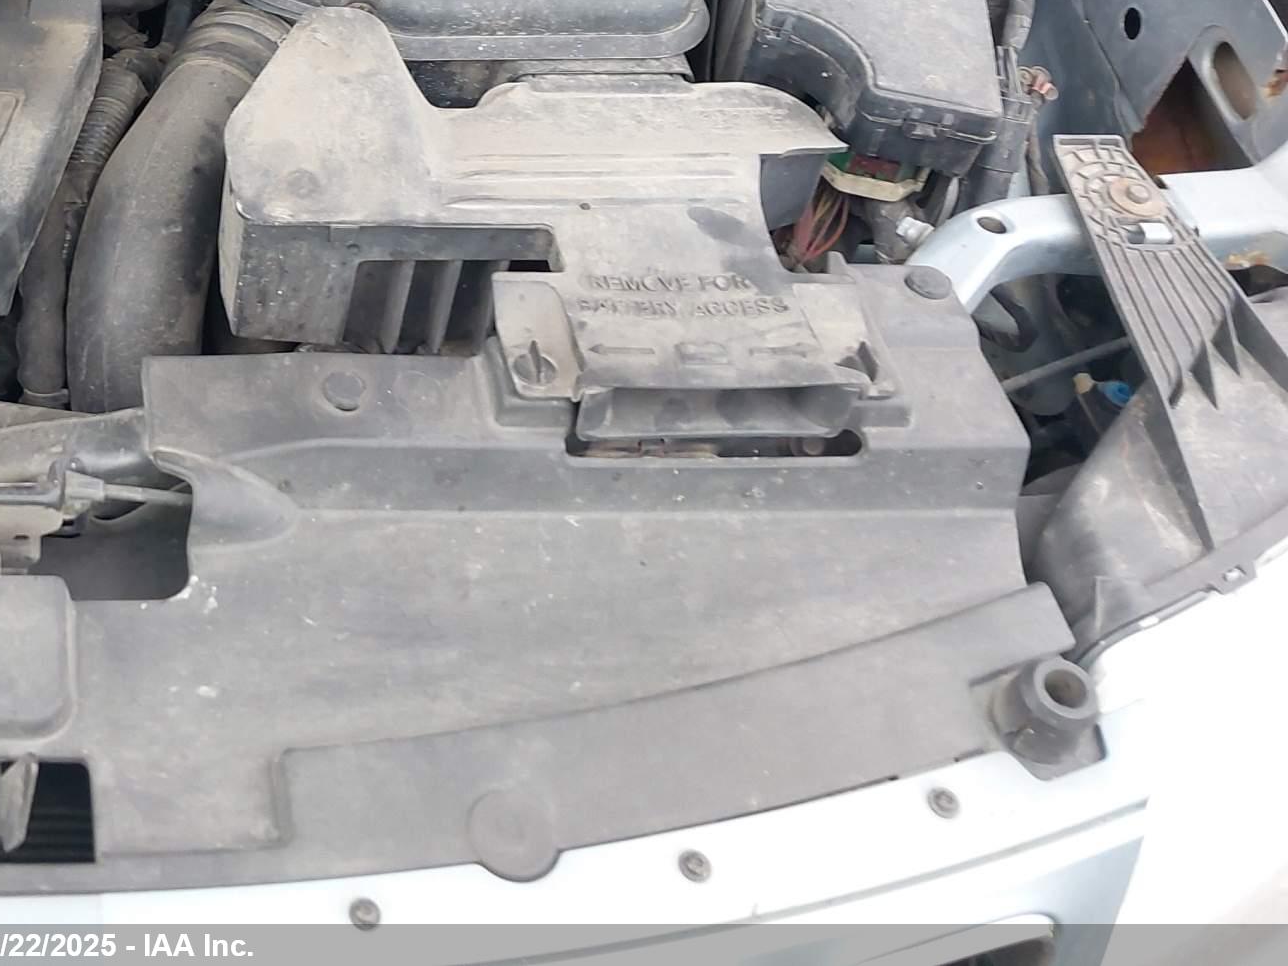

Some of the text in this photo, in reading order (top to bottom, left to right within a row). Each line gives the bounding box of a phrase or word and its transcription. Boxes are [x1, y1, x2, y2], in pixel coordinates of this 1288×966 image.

[585, 272, 751, 292] REMOVE FOR
[575, 294, 790, 316] BATERY ACCESS
